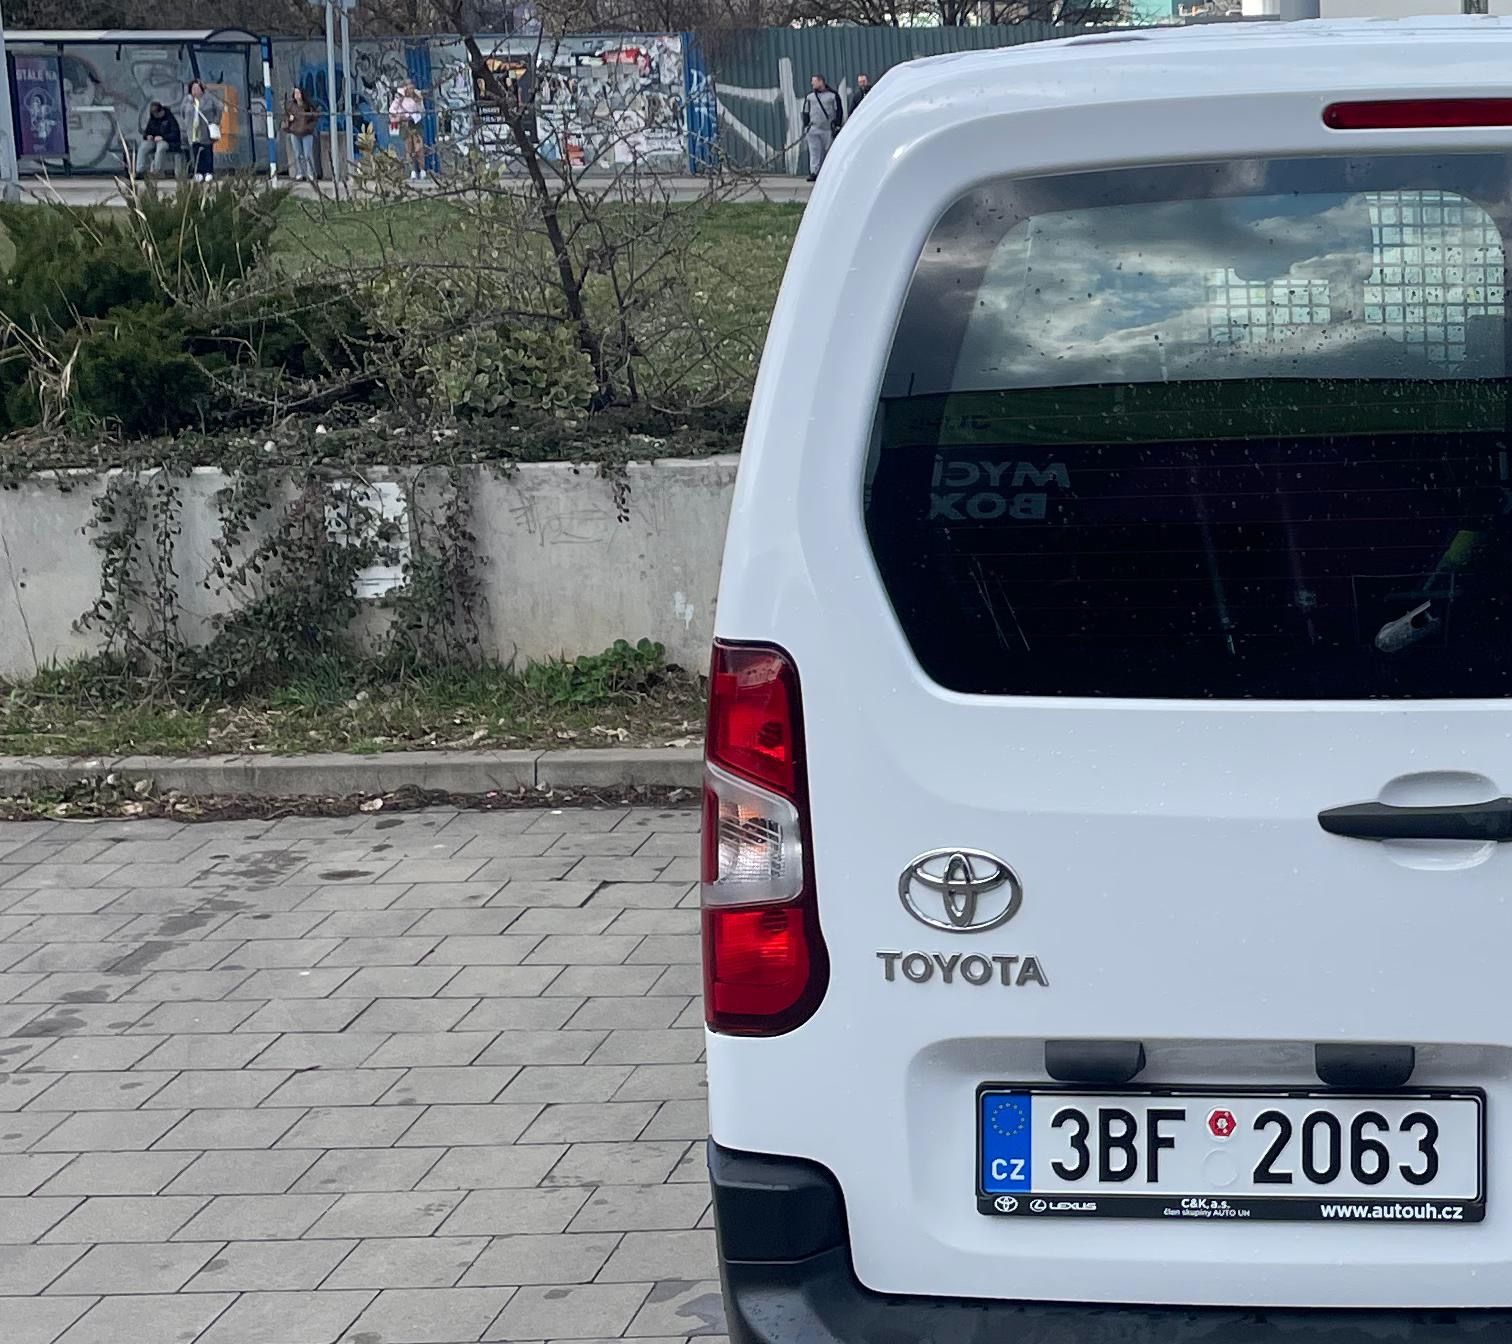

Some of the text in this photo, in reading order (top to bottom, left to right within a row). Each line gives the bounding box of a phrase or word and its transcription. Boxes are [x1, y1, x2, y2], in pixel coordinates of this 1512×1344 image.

[876, 948, 1050, 987] TOYOTA
[991, 1108, 1439, 1186] CZ 3BF 2063
[1049, 1201, 1097, 1210] LEXUS
[1212, 1208, 1236, 1217] AUTO
[1320, 1202, 1464, 1220] www.autouh.cz
